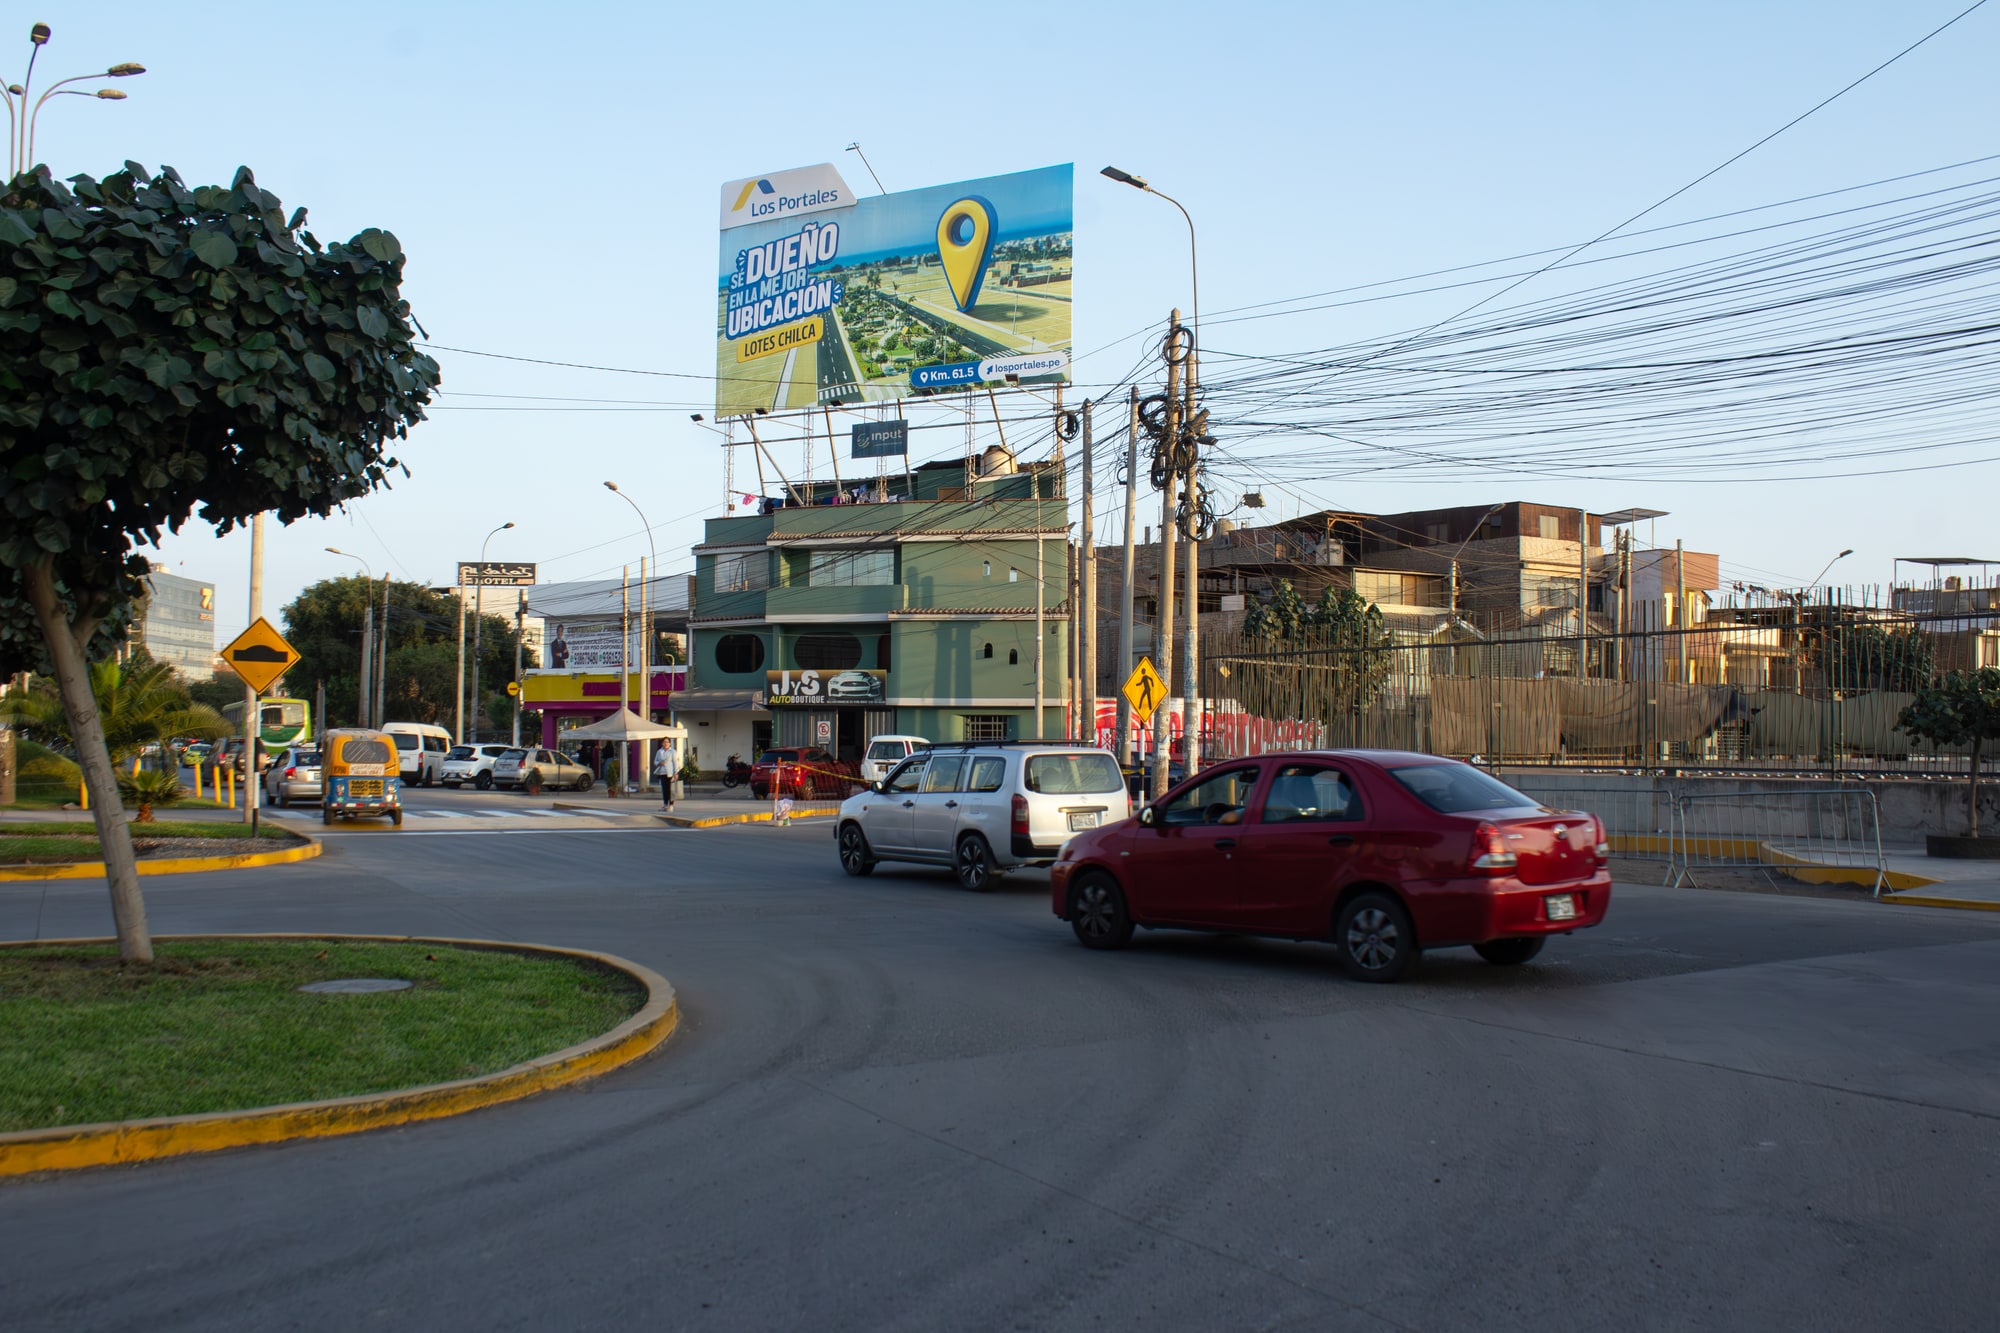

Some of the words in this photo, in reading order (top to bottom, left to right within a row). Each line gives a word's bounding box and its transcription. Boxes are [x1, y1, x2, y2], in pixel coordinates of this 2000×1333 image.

[751, 201, 776, 217] Los
[779, 189, 838, 212] Portales
[730, 267, 745, 290] SÉ
[746, 223, 838, 285] DUEÑO
[729, 291, 743, 310] EN
[744, 287, 758, 305] LA
[759, 268, 807, 300] MEJOR
[728, 277, 832, 336] UBICACIÓN
[744, 335, 775, 357] LOTES
[778, 323, 816, 347] CHILCA
[930, 370, 951, 382] Km.
[952, 367, 974, 379] 61.5
[995, 359, 1060, 374] losportales.pe
[871, 429, 902, 442] input
